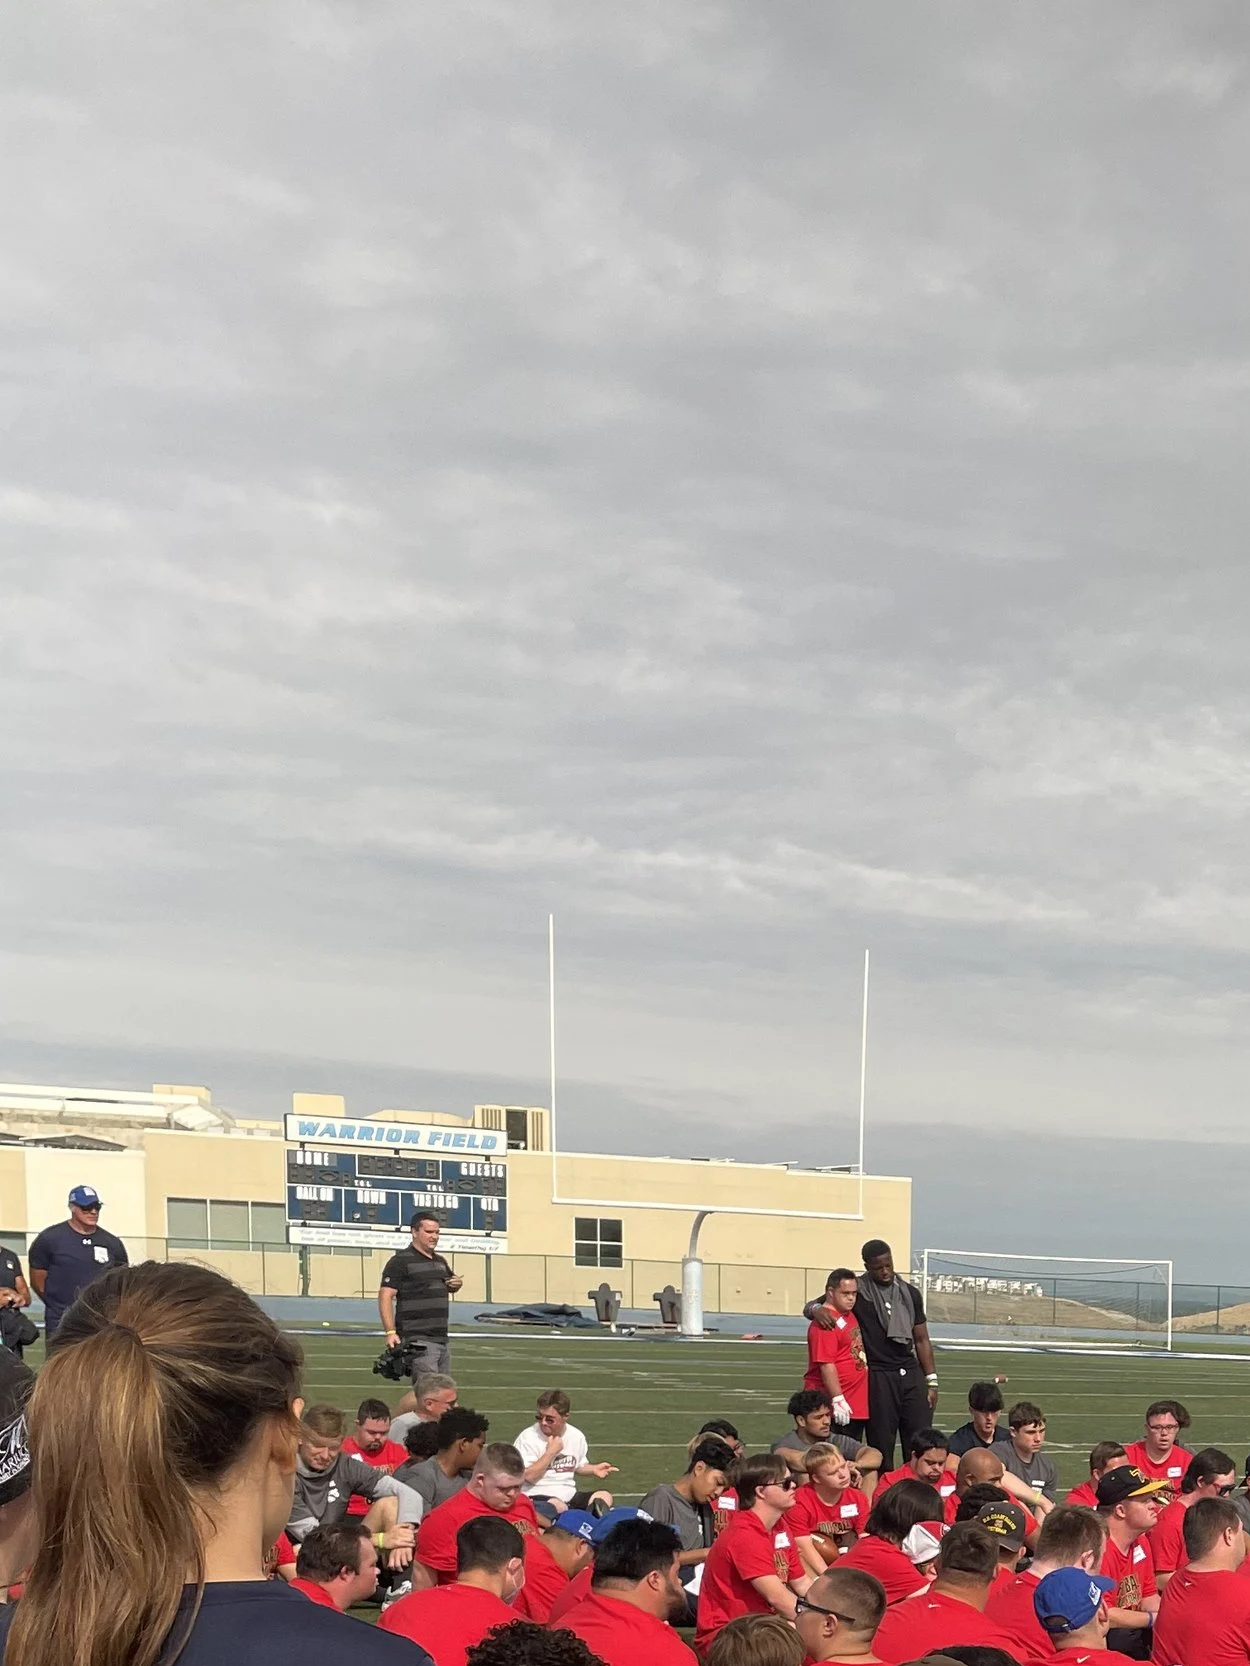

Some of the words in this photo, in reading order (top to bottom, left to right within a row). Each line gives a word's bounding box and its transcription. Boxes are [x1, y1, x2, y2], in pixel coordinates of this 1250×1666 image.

[297, 1120, 420, 1144] WARRIOR
[427, 1130, 498, 1150] FIELD
[460, 1162, 504, 1178] GUESTS
